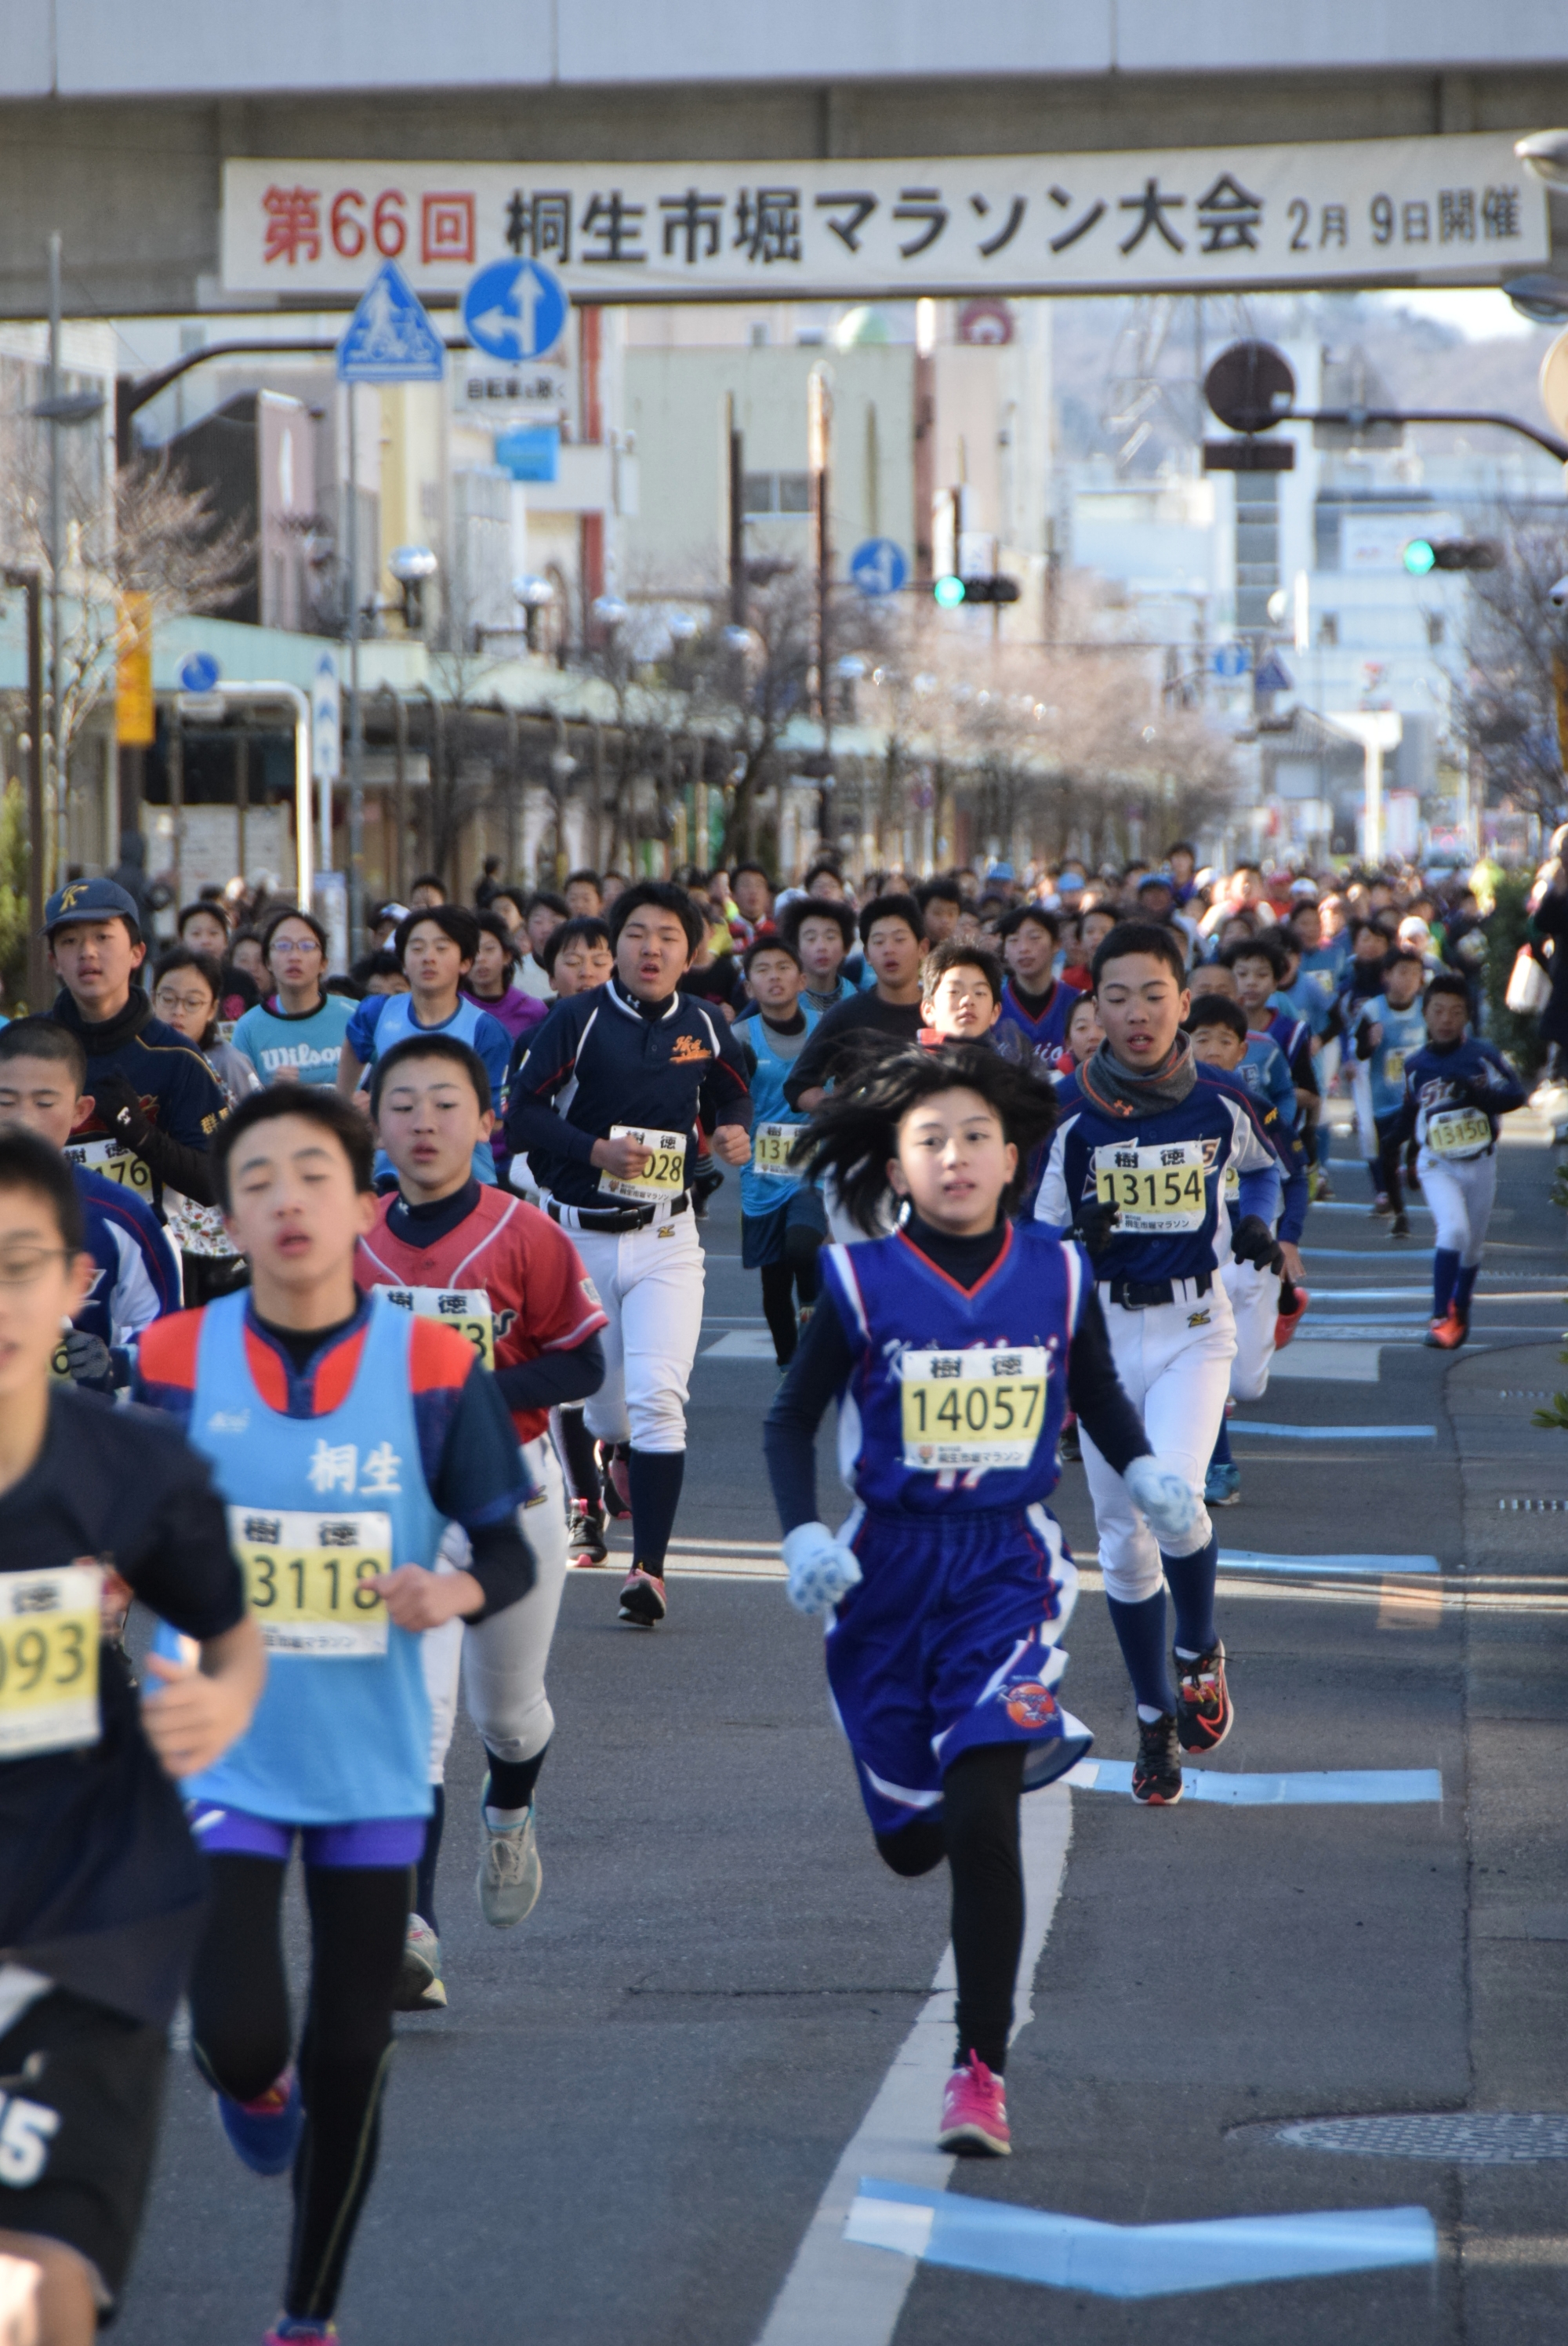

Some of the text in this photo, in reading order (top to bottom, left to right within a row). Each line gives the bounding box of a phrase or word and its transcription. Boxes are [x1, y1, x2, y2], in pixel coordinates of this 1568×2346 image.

[262, 184, 476, 265] 第66回
[505, 171, 1264, 265] 桐生市堀マラソン大会
[60, 884, 89, 913] K
[1432, 1119, 1489, 1146] 13150
[1103, 1169, 1202, 1206] 13154
[912, 1383, 1040, 1431] 14057
[308, 1439, 402, 1494] 桐生
[251, 1555, 383, 1609] 3118
